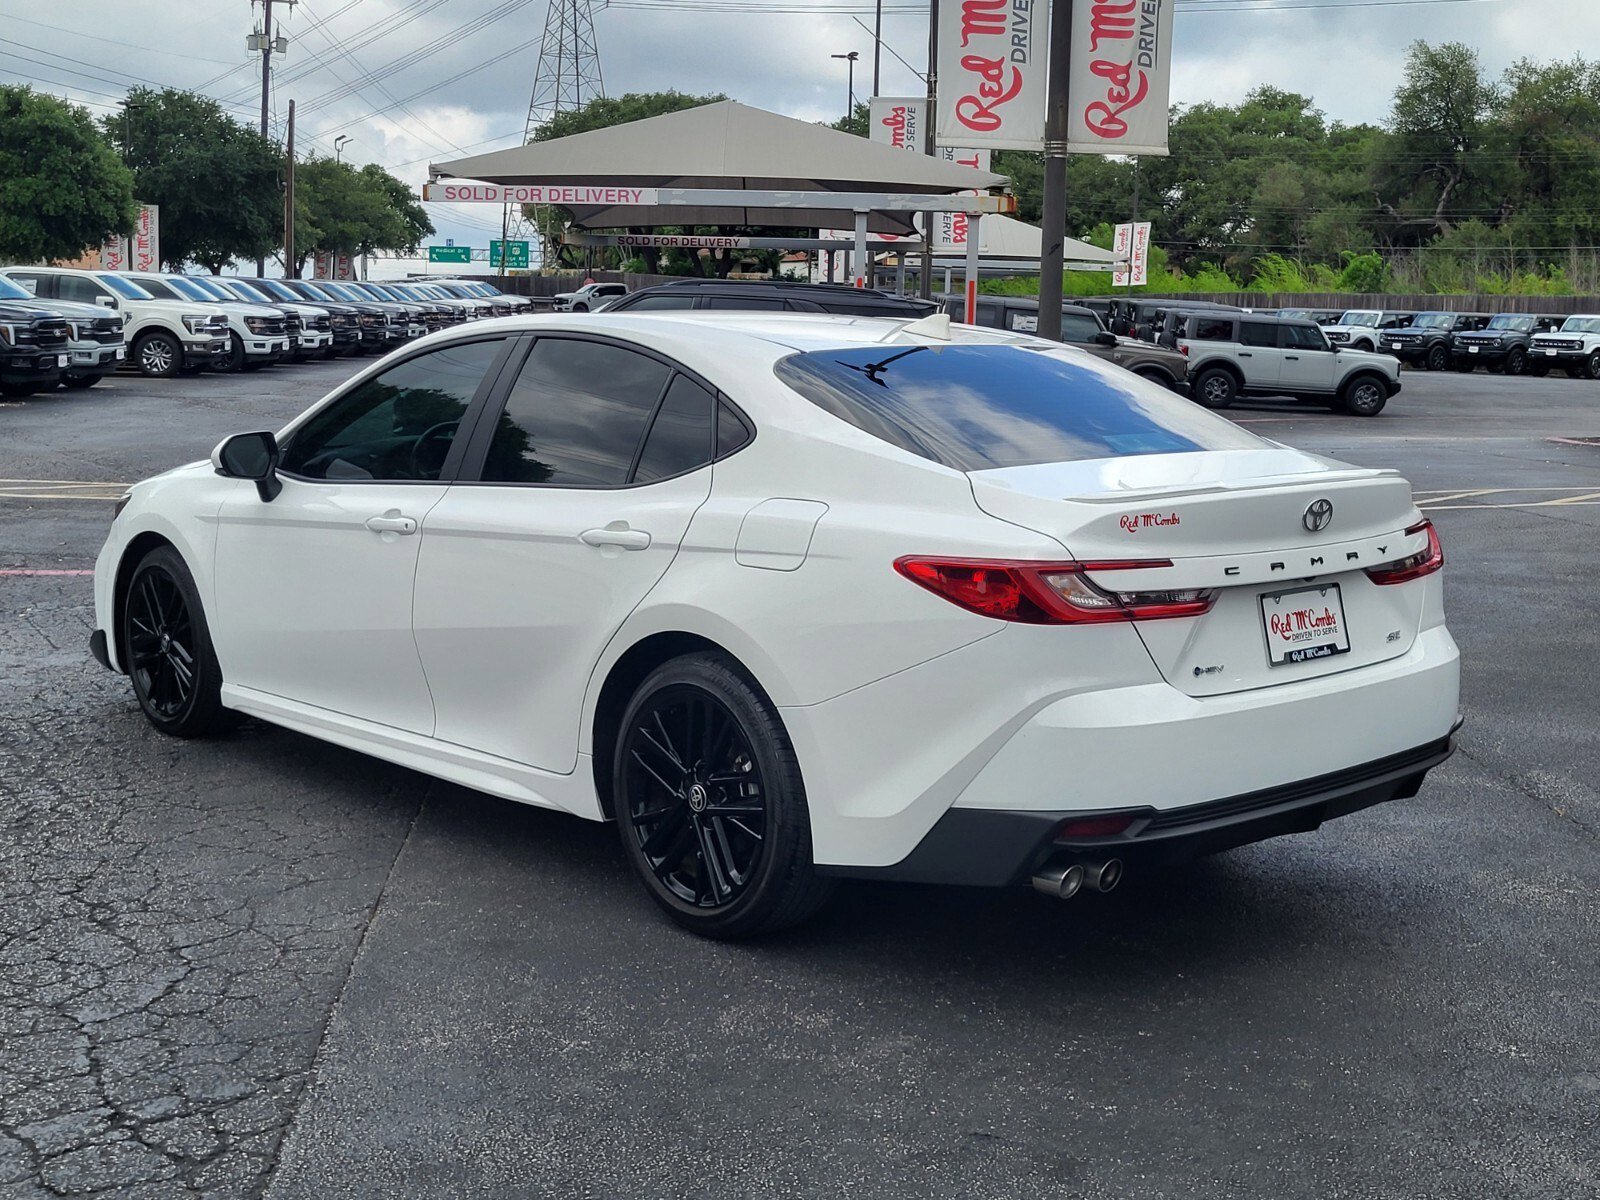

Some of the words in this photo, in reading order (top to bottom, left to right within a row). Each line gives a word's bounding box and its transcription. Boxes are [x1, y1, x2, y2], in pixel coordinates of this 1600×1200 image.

[1010, 0, 1029, 64] DRIVE
[1137, 0, 1156, 68] DRIVE
[956, 55, 1023, 132] Red
[1084, 60, 1149, 138] Red
[906, 107, 916, 142] SERVE
[445, 187, 497, 200] SOLD
[503, 188, 542, 202] FOR
[549, 188, 643, 204] DELIVERY
[617, 236, 650, 245] SOLD
[653, 237, 678, 246] FOR
[681, 237, 740, 247] DELIVERY
[106, 252, 123, 270] Red
[137, 253, 153, 271] Red
[1120, 515, 1139, 533] Red
[1140, 513, 1180, 527] McCombs
[1224, 545, 1388, 576] CAMRY
[1271, 613, 1292, 641] Red
[1291, 607, 1337, 631] McCombs
[1292, 631, 1312, 641] DRIVEN
[1313, 629, 1322, 637] TO
[1322, 626, 1338, 636] SERVE
[1386, 630, 1401, 643] SE
[1292, 650, 1305, 662] Red
[1305, 646, 1332, 659] McCombs
